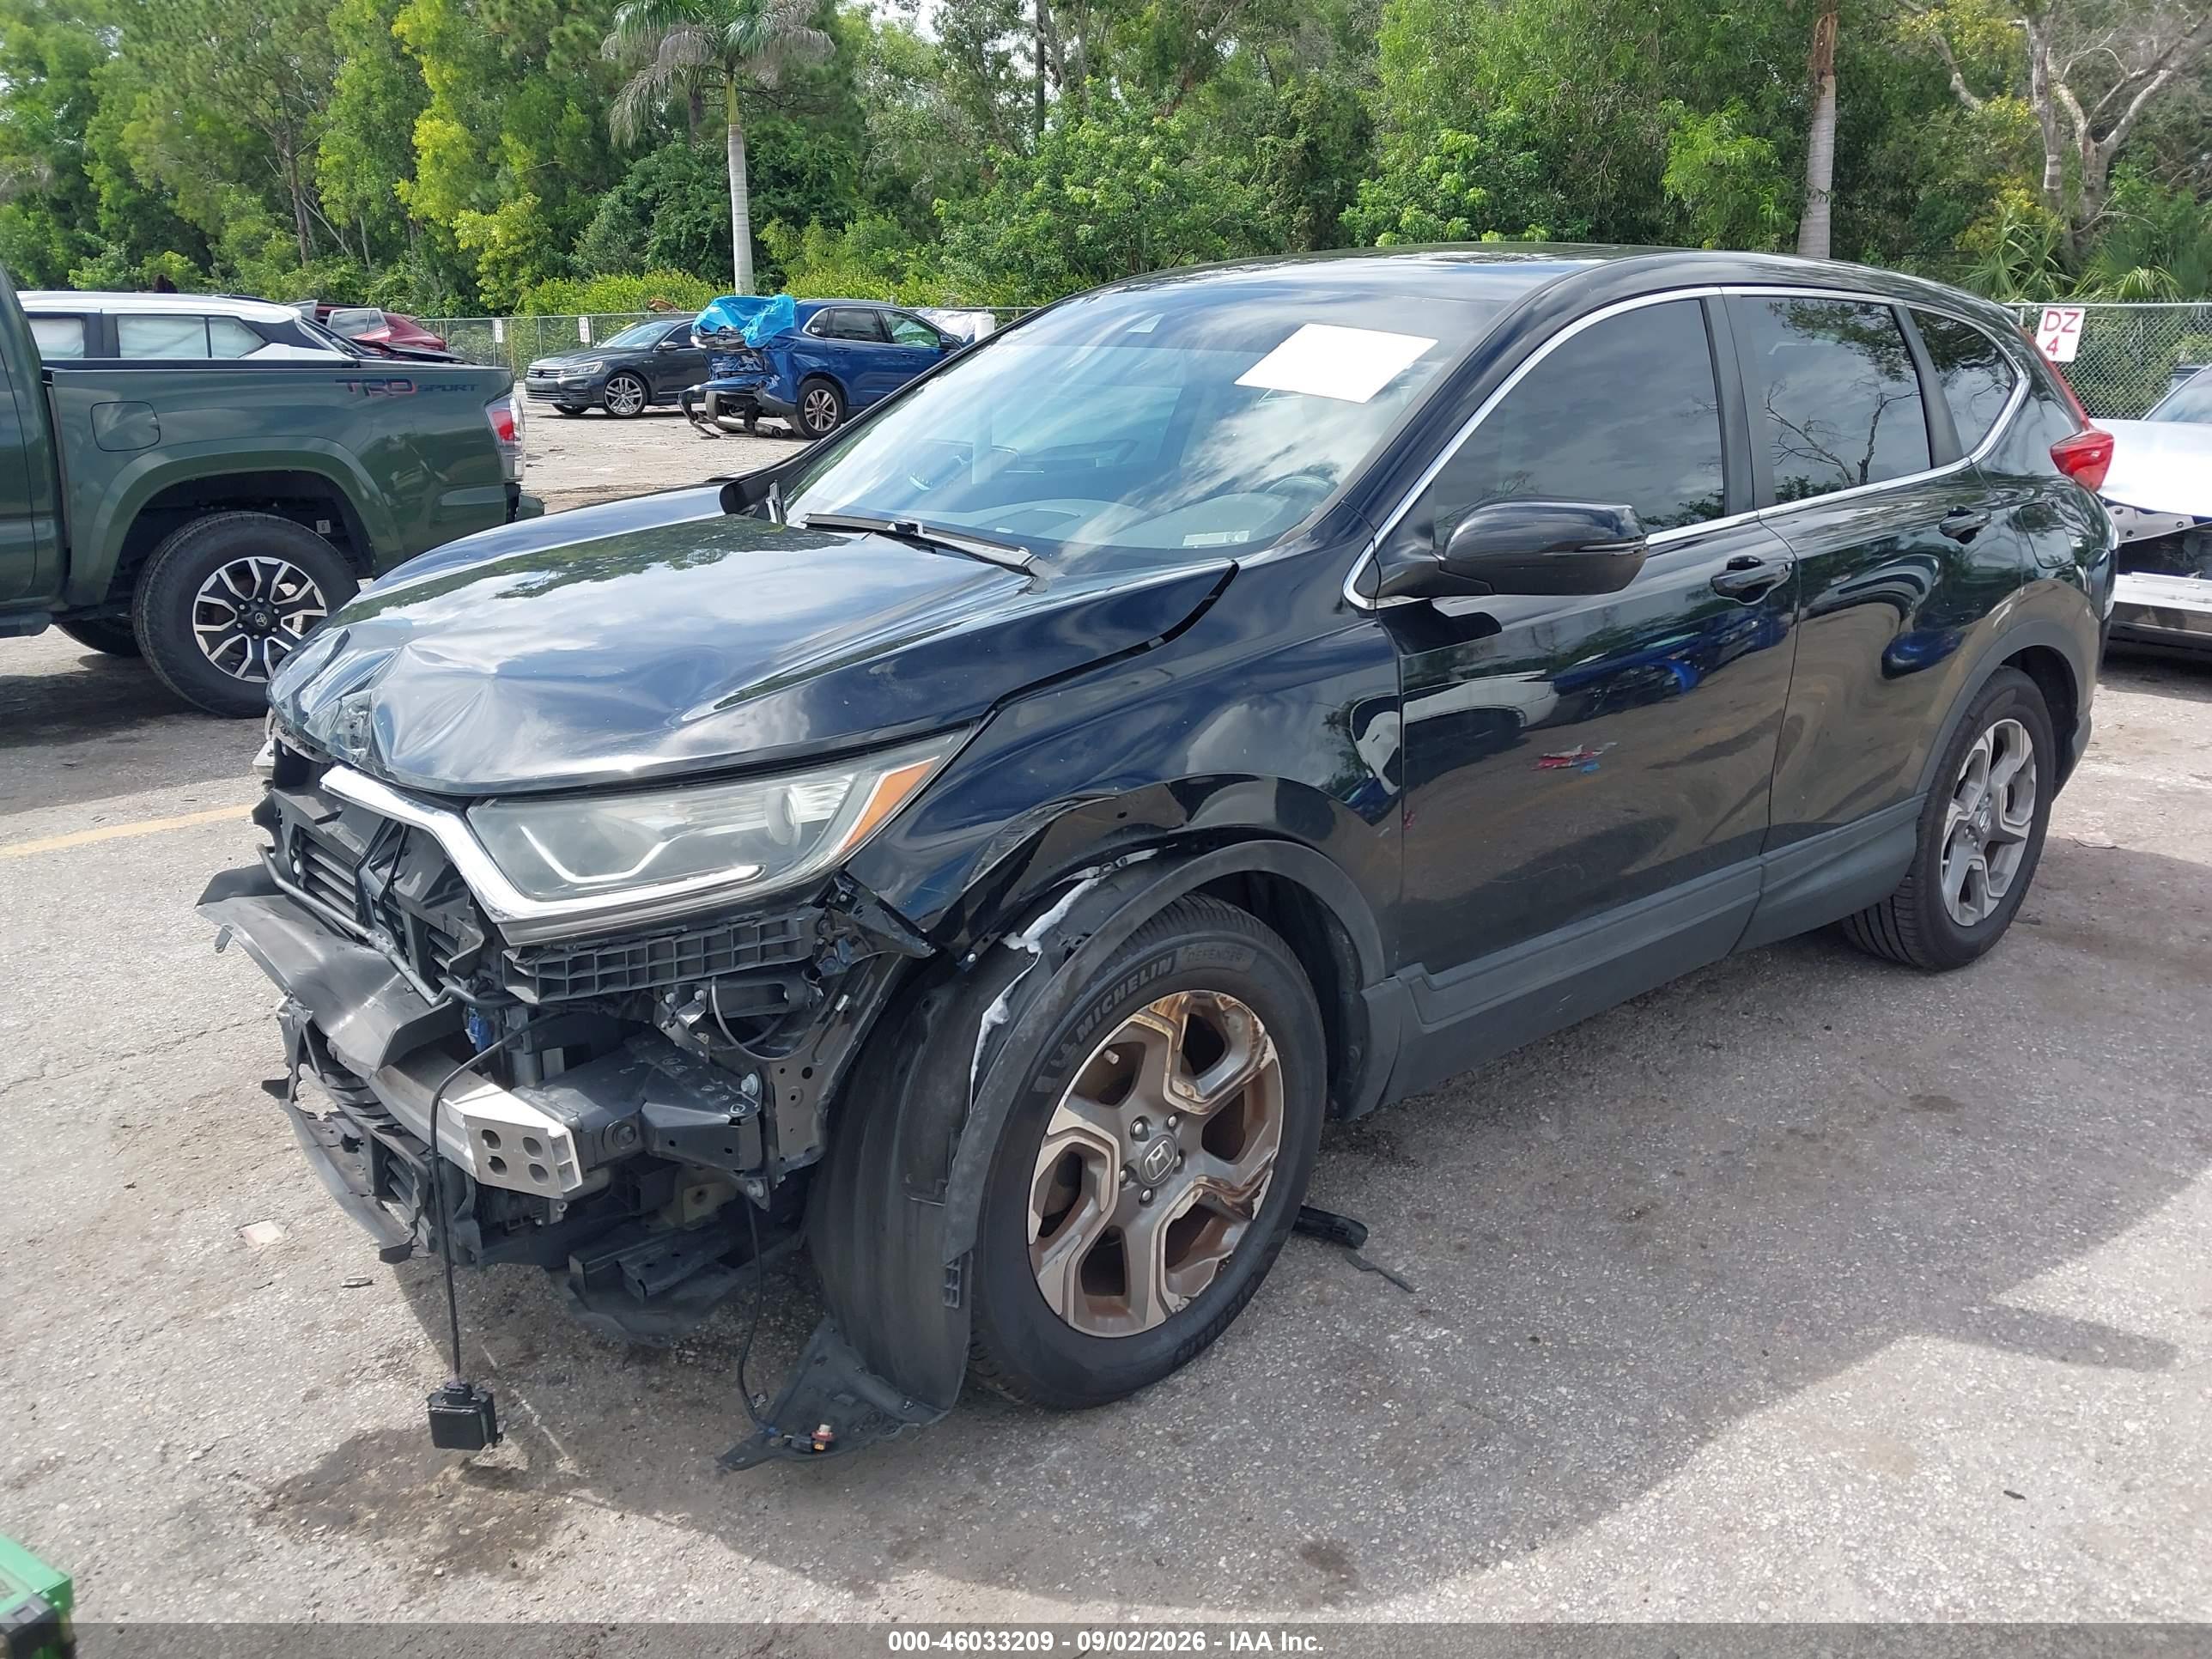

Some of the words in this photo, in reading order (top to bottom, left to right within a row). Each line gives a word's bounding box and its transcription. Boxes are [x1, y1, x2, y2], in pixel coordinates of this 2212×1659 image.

[2044, 311, 2080, 333] DZ
[2045, 335, 2059, 356] 4
[335, 378, 416, 398] TRD
[418, 384, 479, 392] SPORT
[1076, 956, 1174, 1043] MICHELIN
